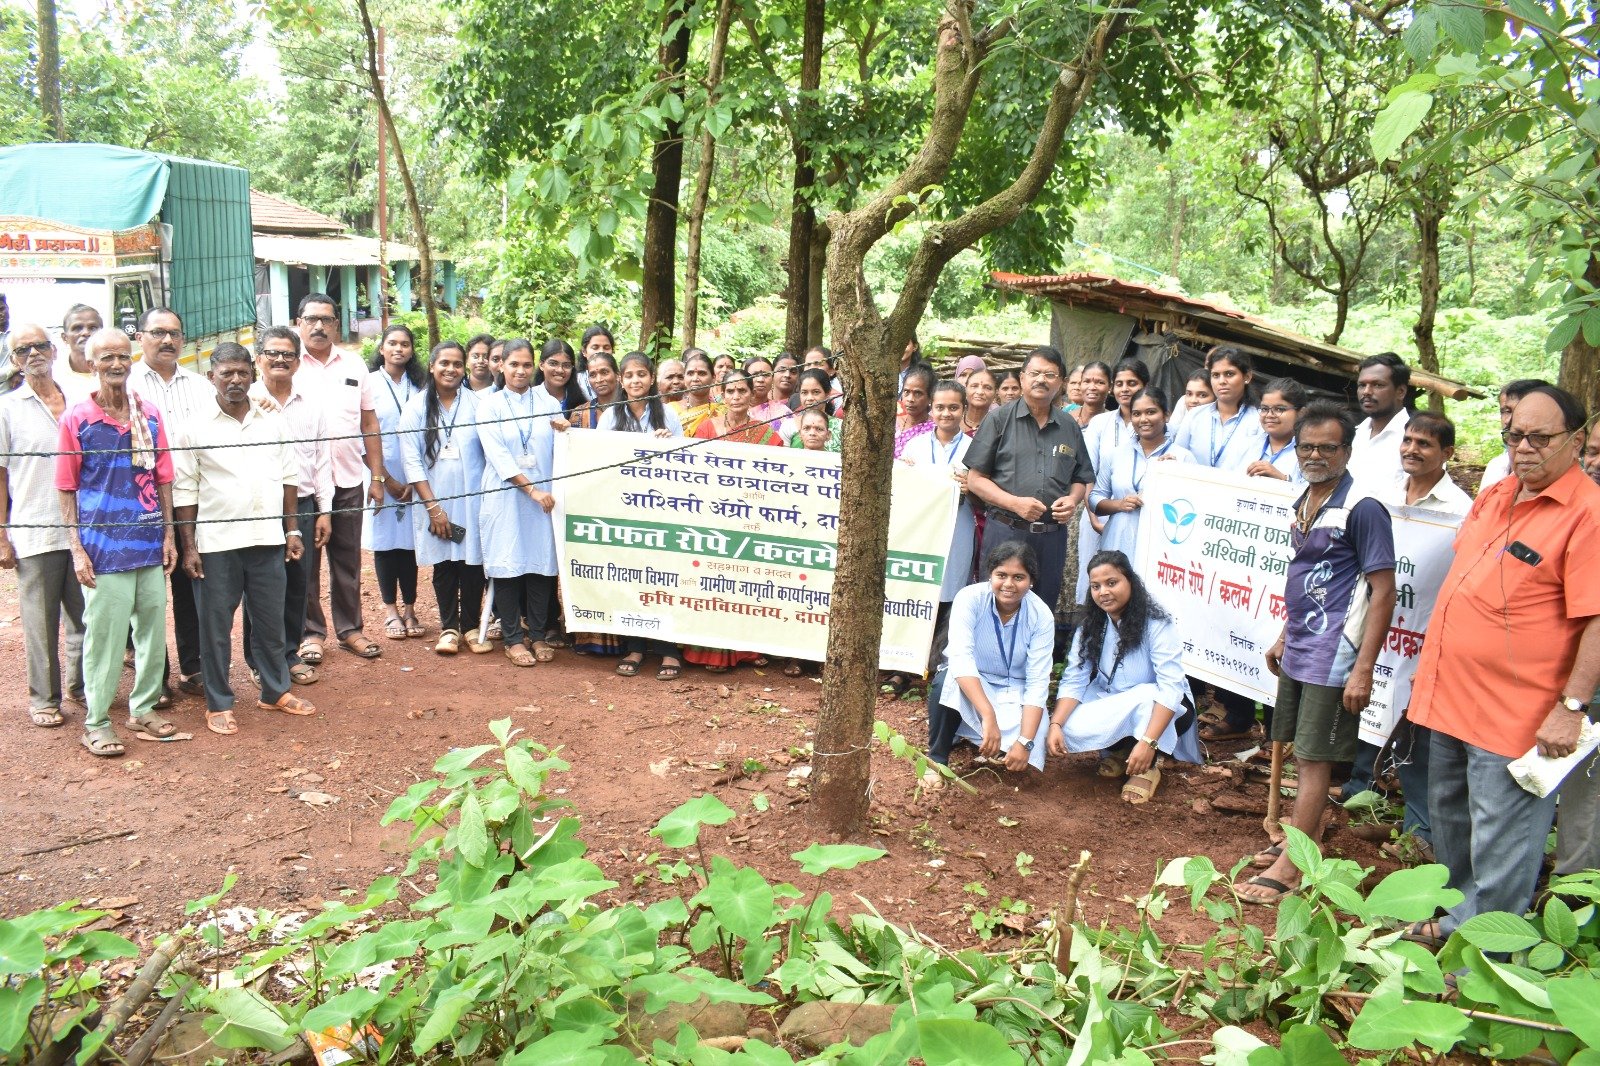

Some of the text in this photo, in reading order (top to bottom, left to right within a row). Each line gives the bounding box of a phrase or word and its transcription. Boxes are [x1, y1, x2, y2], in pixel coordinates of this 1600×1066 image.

[703, 451, 746, 471] सेवा
[620, 465, 709, 486] नवभारत
[717, 473, 809, 497] छात्रालय
[572, 518, 670, 549] मोफत
[1204, 513, 1261, 540] नवभारत
[1201, 538, 1257, 568] अश्विनी
[570, 558, 604, 580] विस्तार
[607, 562, 642, 583] शिक्षण
[645, 566, 680, 588] विभाग
[700, 574, 736, 595] ग्रामीण
[738, 579, 775, 603] जागृती
[883, 598, 933, 621] वद्यार्थिनी
[639, 590, 675, 607] कृषि
[572, 604, 605, 621] ठिकाण
